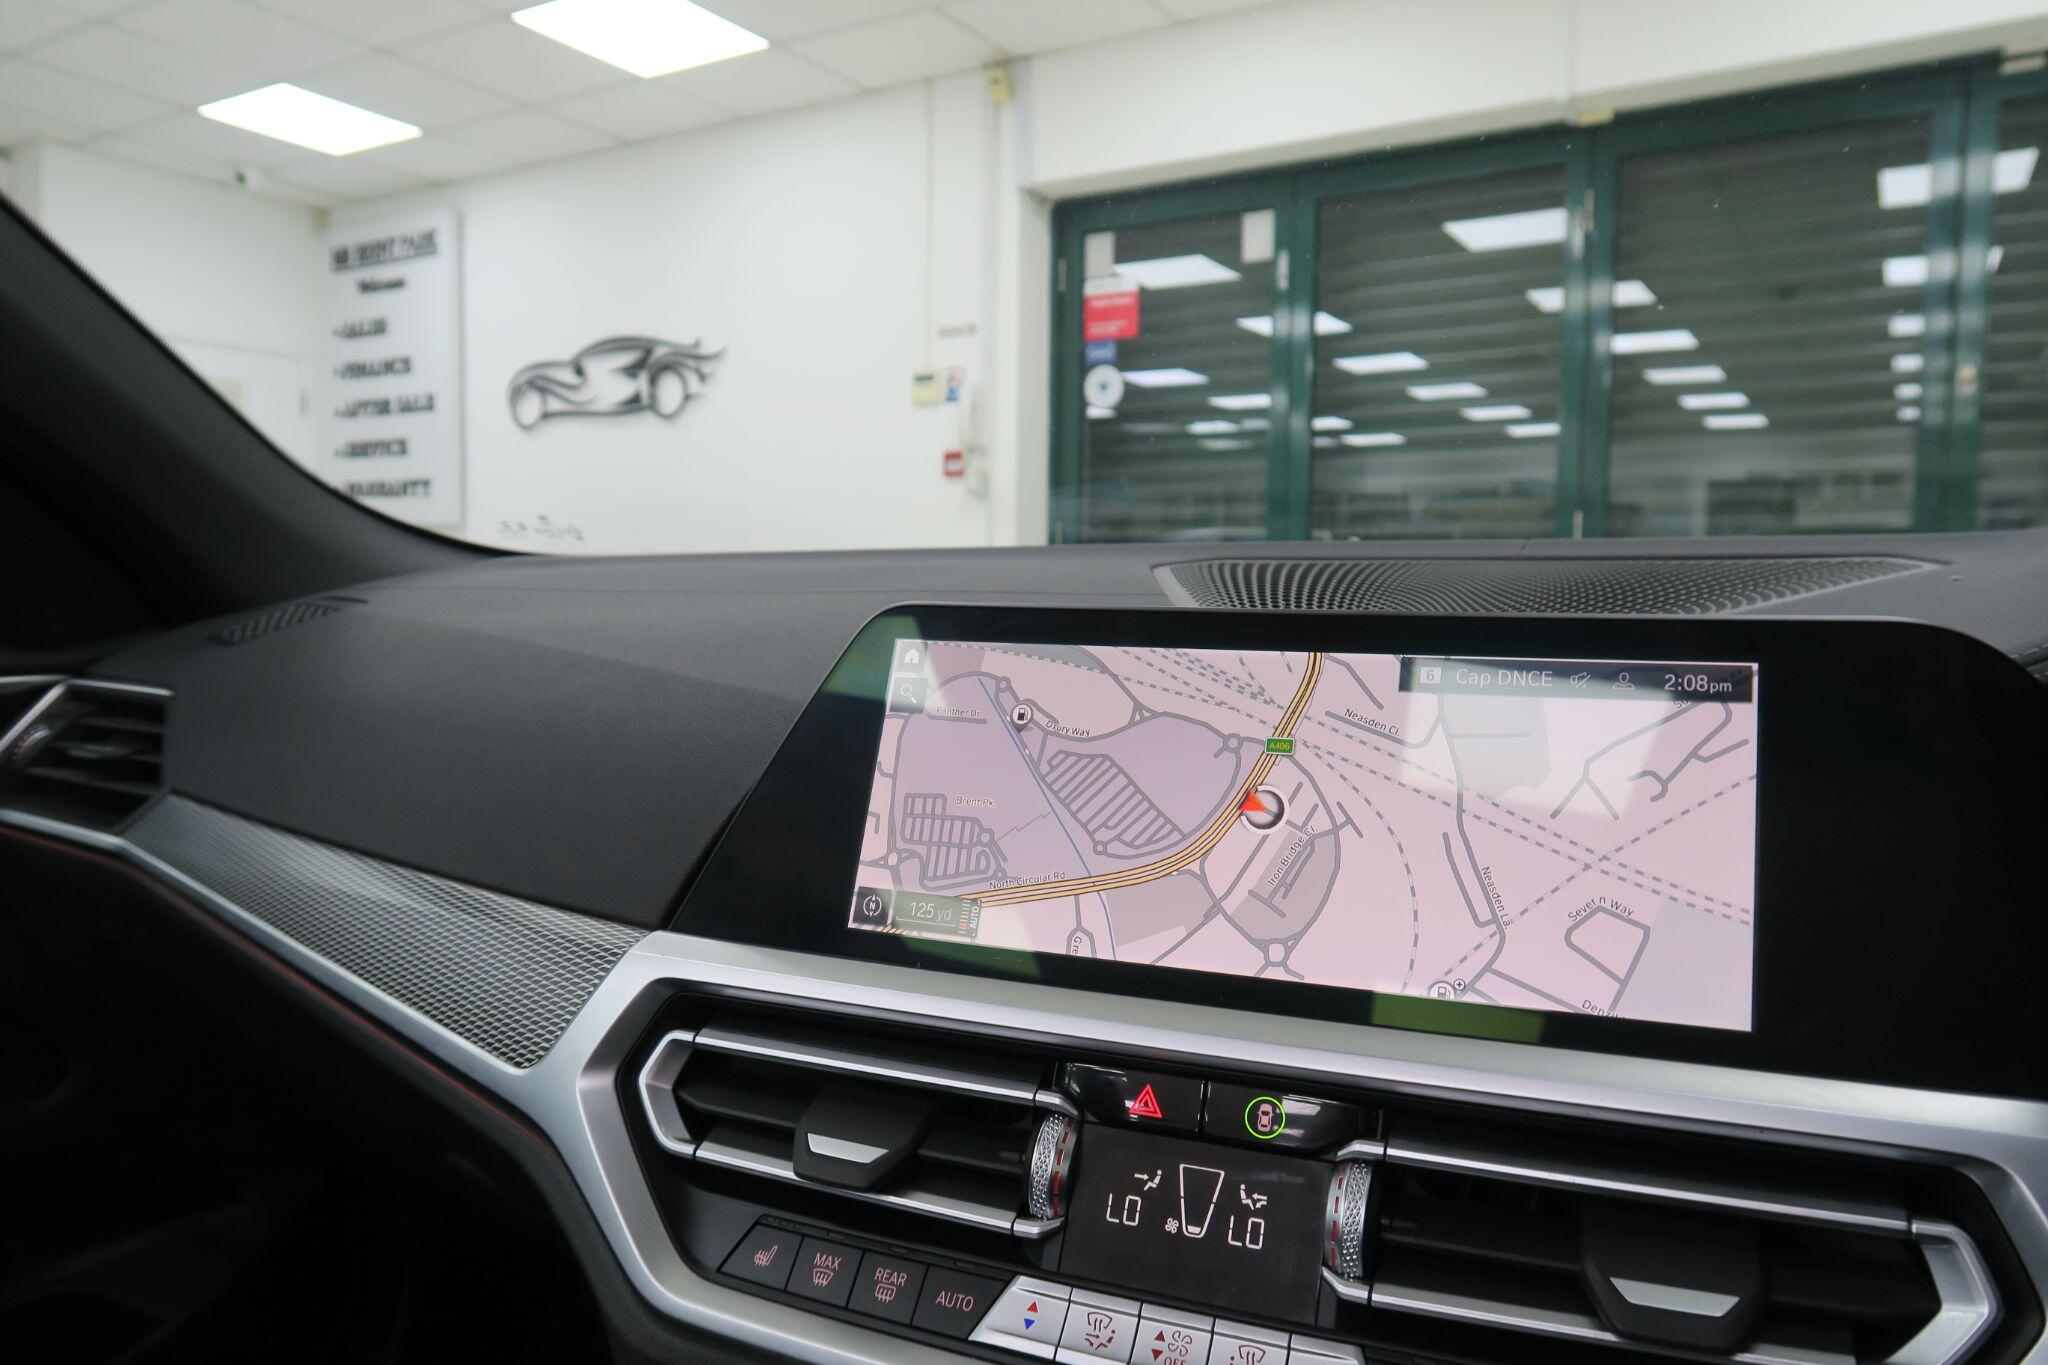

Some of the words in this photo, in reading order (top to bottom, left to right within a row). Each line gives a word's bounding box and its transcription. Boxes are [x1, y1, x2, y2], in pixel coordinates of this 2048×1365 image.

[1456, 668, 1491, 688] Cap
[1498, 670, 1553, 687] DNCE
[936, 706, 968, 718] Panther
[1344, 708, 1387, 731] Neasden
[1045, 719, 1070, 734] Drury
[1071, 726, 1091, 738] Way
[1269, 740, 1290, 750] A406
[956, 796, 980, 807] Brent
[1267, 865, 1286, 887] Iron
[1280, 835, 1305, 867] Bridge
[989, 877, 1014, 889] North
[1016, 873, 1053, 885] Circular
[1481, 866, 1506, 913] Neasden
[909, 901, 934, 920] 125
[936, 908, 952, 922] yd
[969, 906, 980, 930] AUTO
[1609, 899, 1634, 917] Way
[814, 1252, 842, 1271] MAX
[874, 1267, 907, 1287] REAR
[935, 1290, 974, 1312] AUTO
